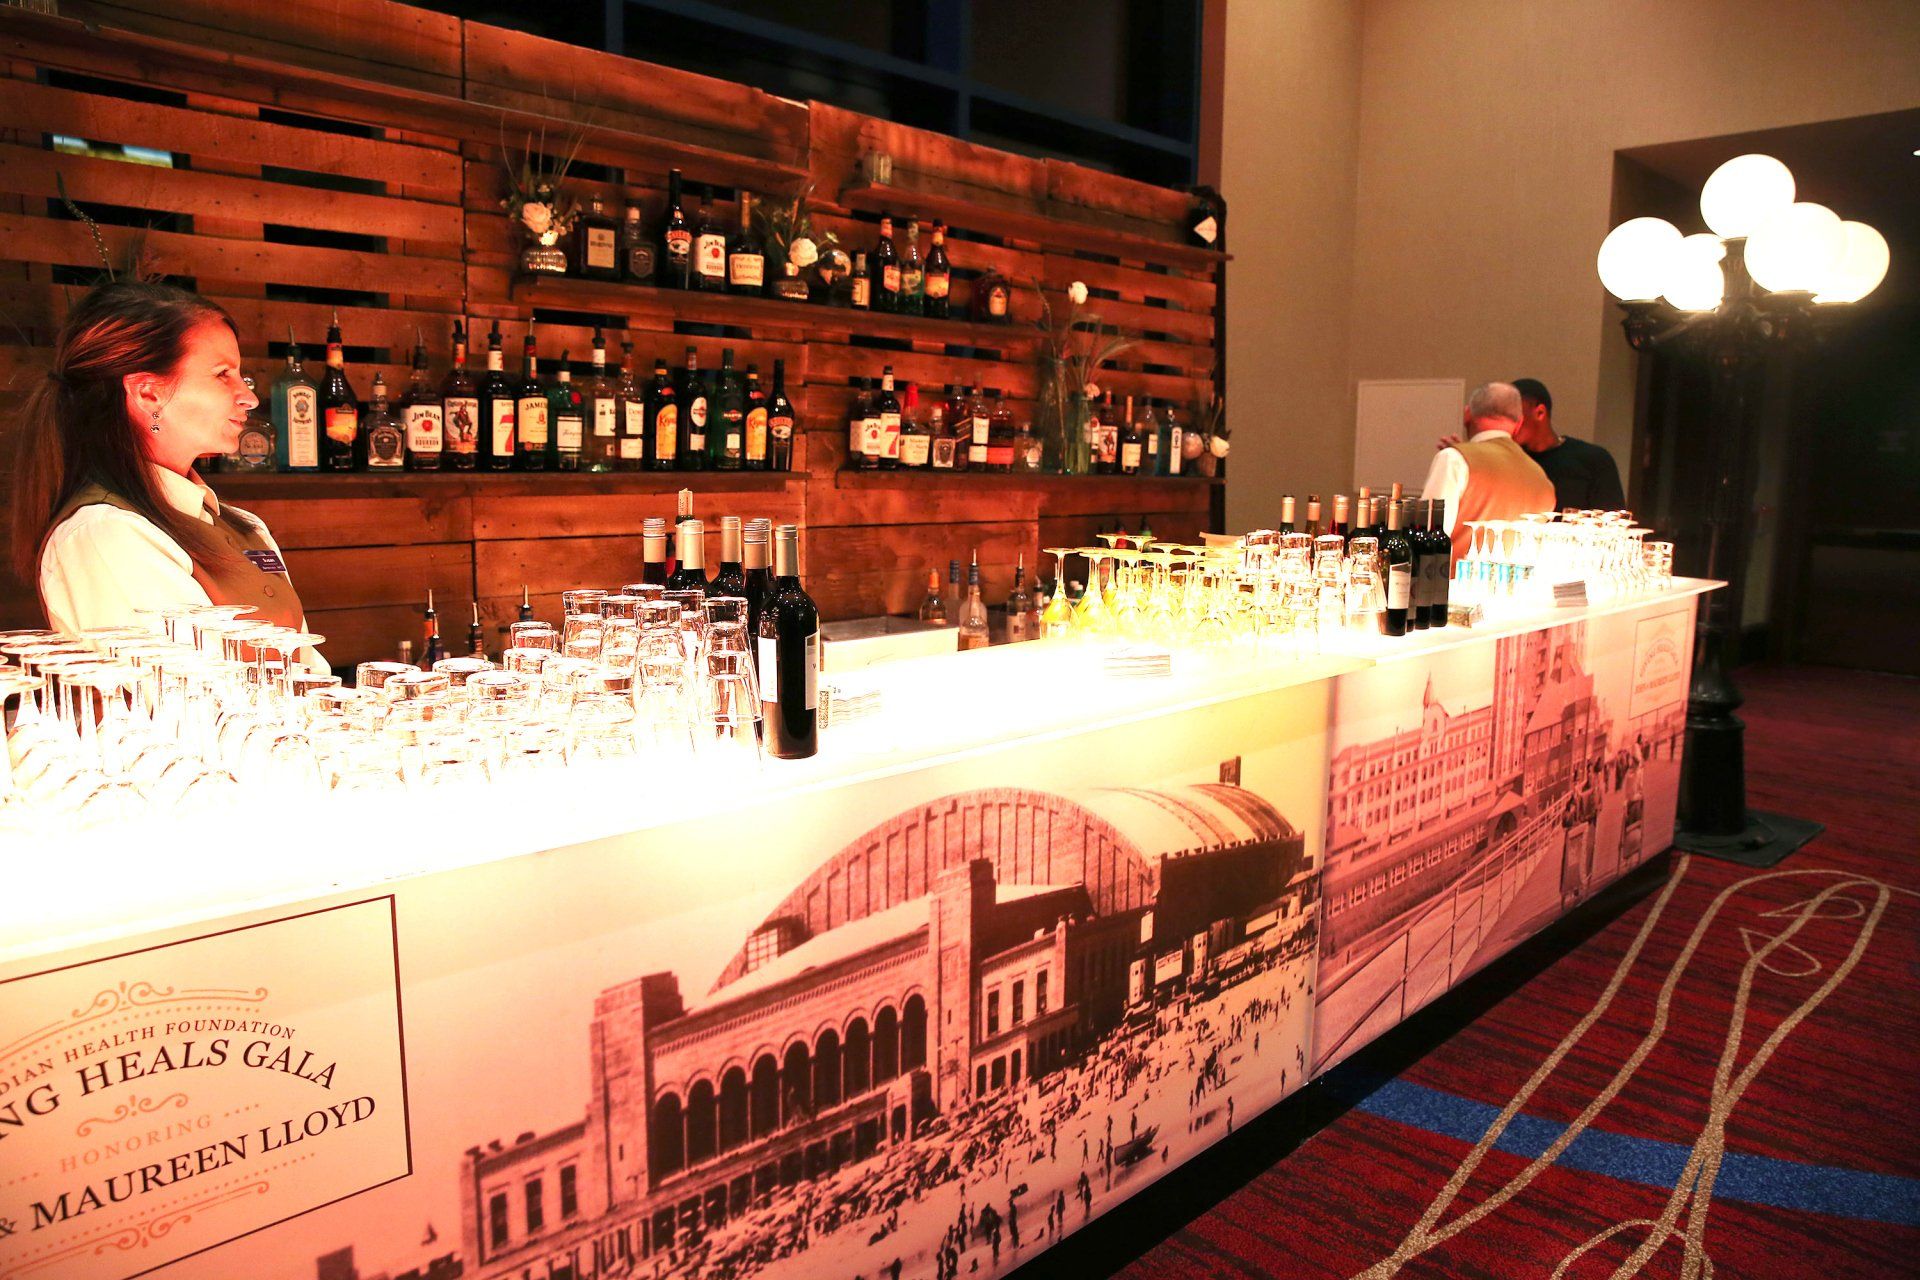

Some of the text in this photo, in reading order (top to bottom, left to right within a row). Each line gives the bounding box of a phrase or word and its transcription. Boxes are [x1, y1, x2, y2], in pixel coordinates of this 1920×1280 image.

[64, 1026, 155, 1064] HEALTH
[166, 1018, 296, 1040] FOUNDATION
[75, 1039, 230, 1097] HEALS
[243, 1040, 337, 1090] GALA
[29, 1134, 249, 1232] MAUREEN
[259, 1096, 376, 1153] LLOYD
[60, 1114, 211, 1173] HONORING
